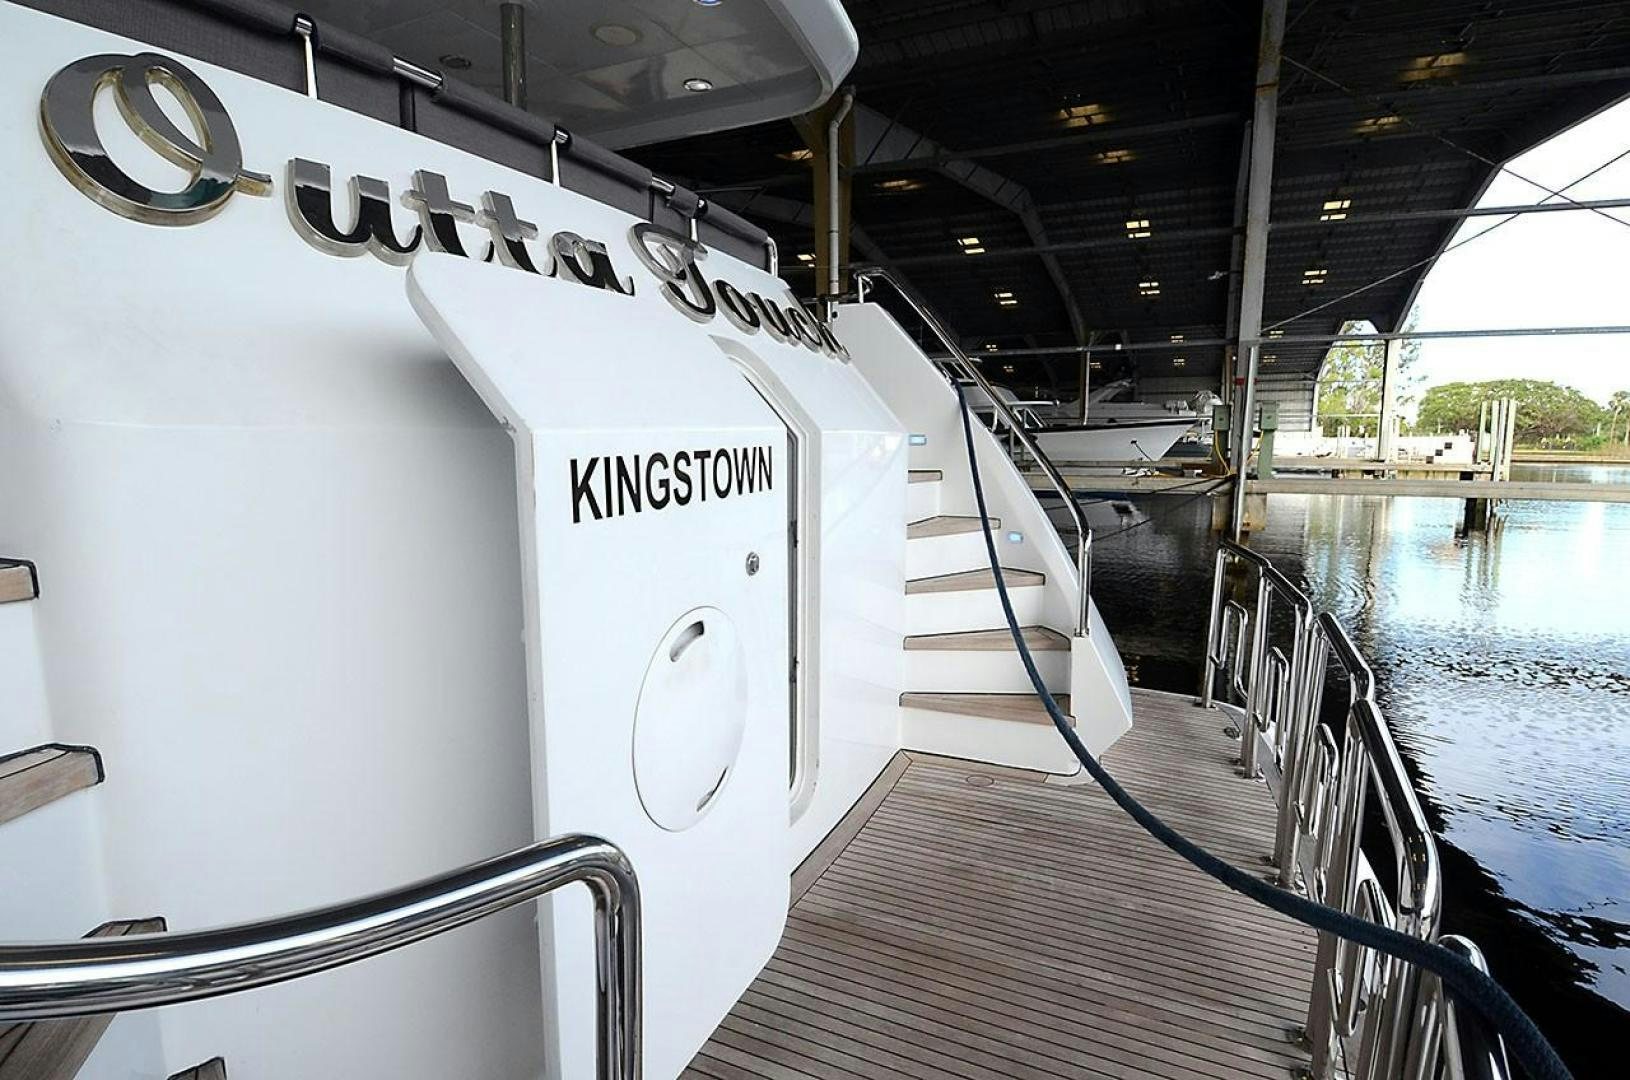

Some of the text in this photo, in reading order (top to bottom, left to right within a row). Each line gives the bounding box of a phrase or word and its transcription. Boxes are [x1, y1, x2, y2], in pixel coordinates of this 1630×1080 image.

[39, 52, 852, 364] Outta Touch
[570, 446, 772, 523] KINGSTOWN
